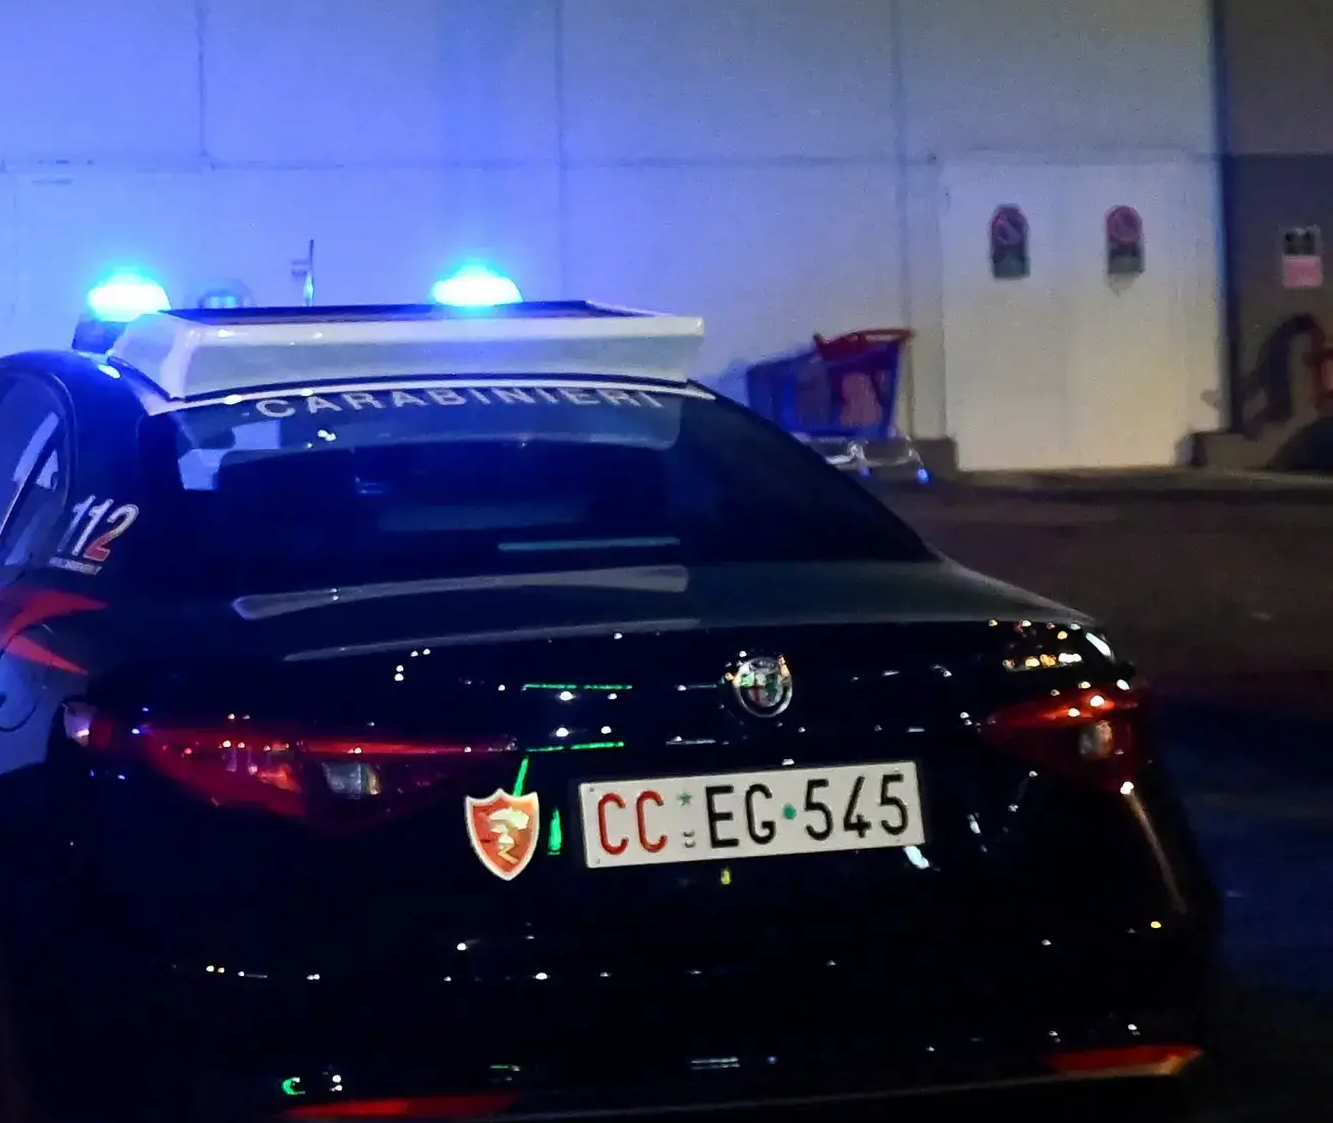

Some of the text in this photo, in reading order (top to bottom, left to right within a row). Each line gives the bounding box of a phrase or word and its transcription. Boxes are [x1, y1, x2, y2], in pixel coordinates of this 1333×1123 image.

[255, 387, 665, 419] CARABINIERI
[57, 494, 140, 562] 112
[596, 790, 668, 856] CC
